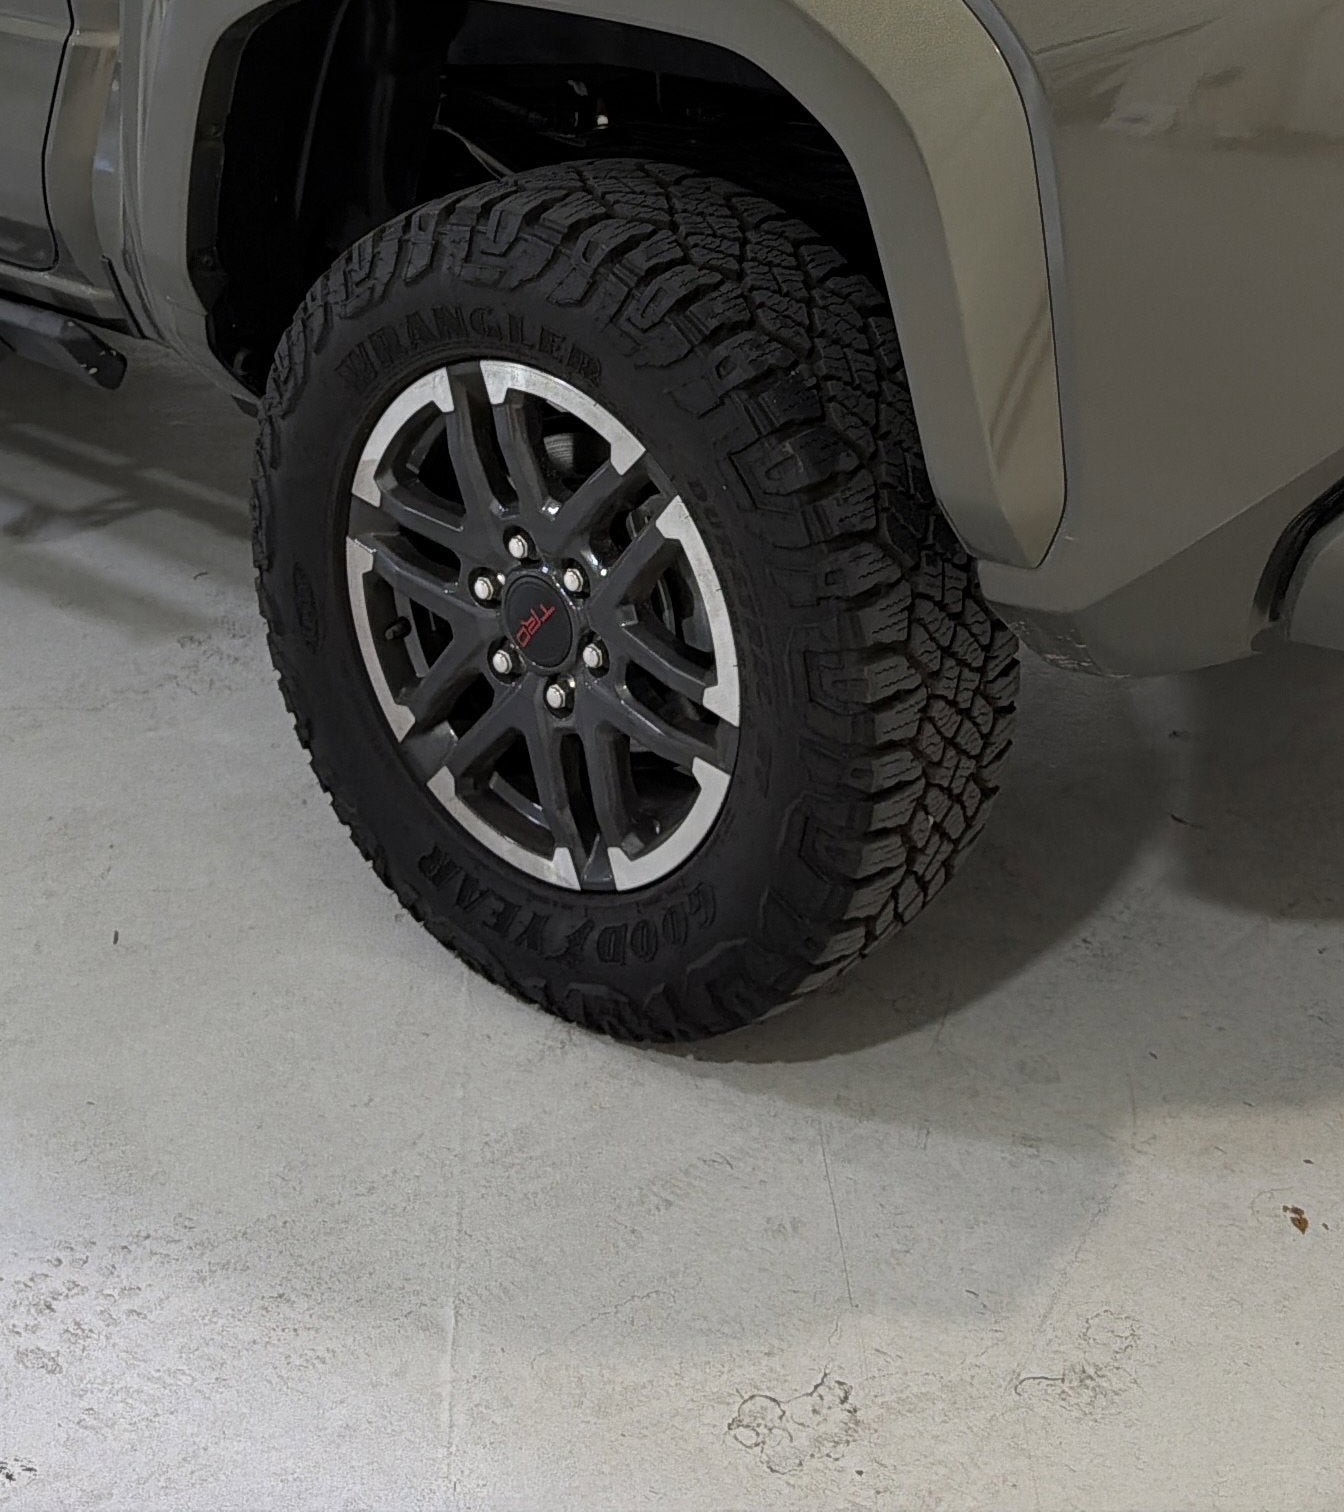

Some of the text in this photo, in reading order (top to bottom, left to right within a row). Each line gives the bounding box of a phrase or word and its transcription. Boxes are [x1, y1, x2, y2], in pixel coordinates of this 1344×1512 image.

[335, 305, 602, 389] WRANGLER
[514, 604, 556, 647] TRD
[418, 844, 717, 966] GOODYEAR
